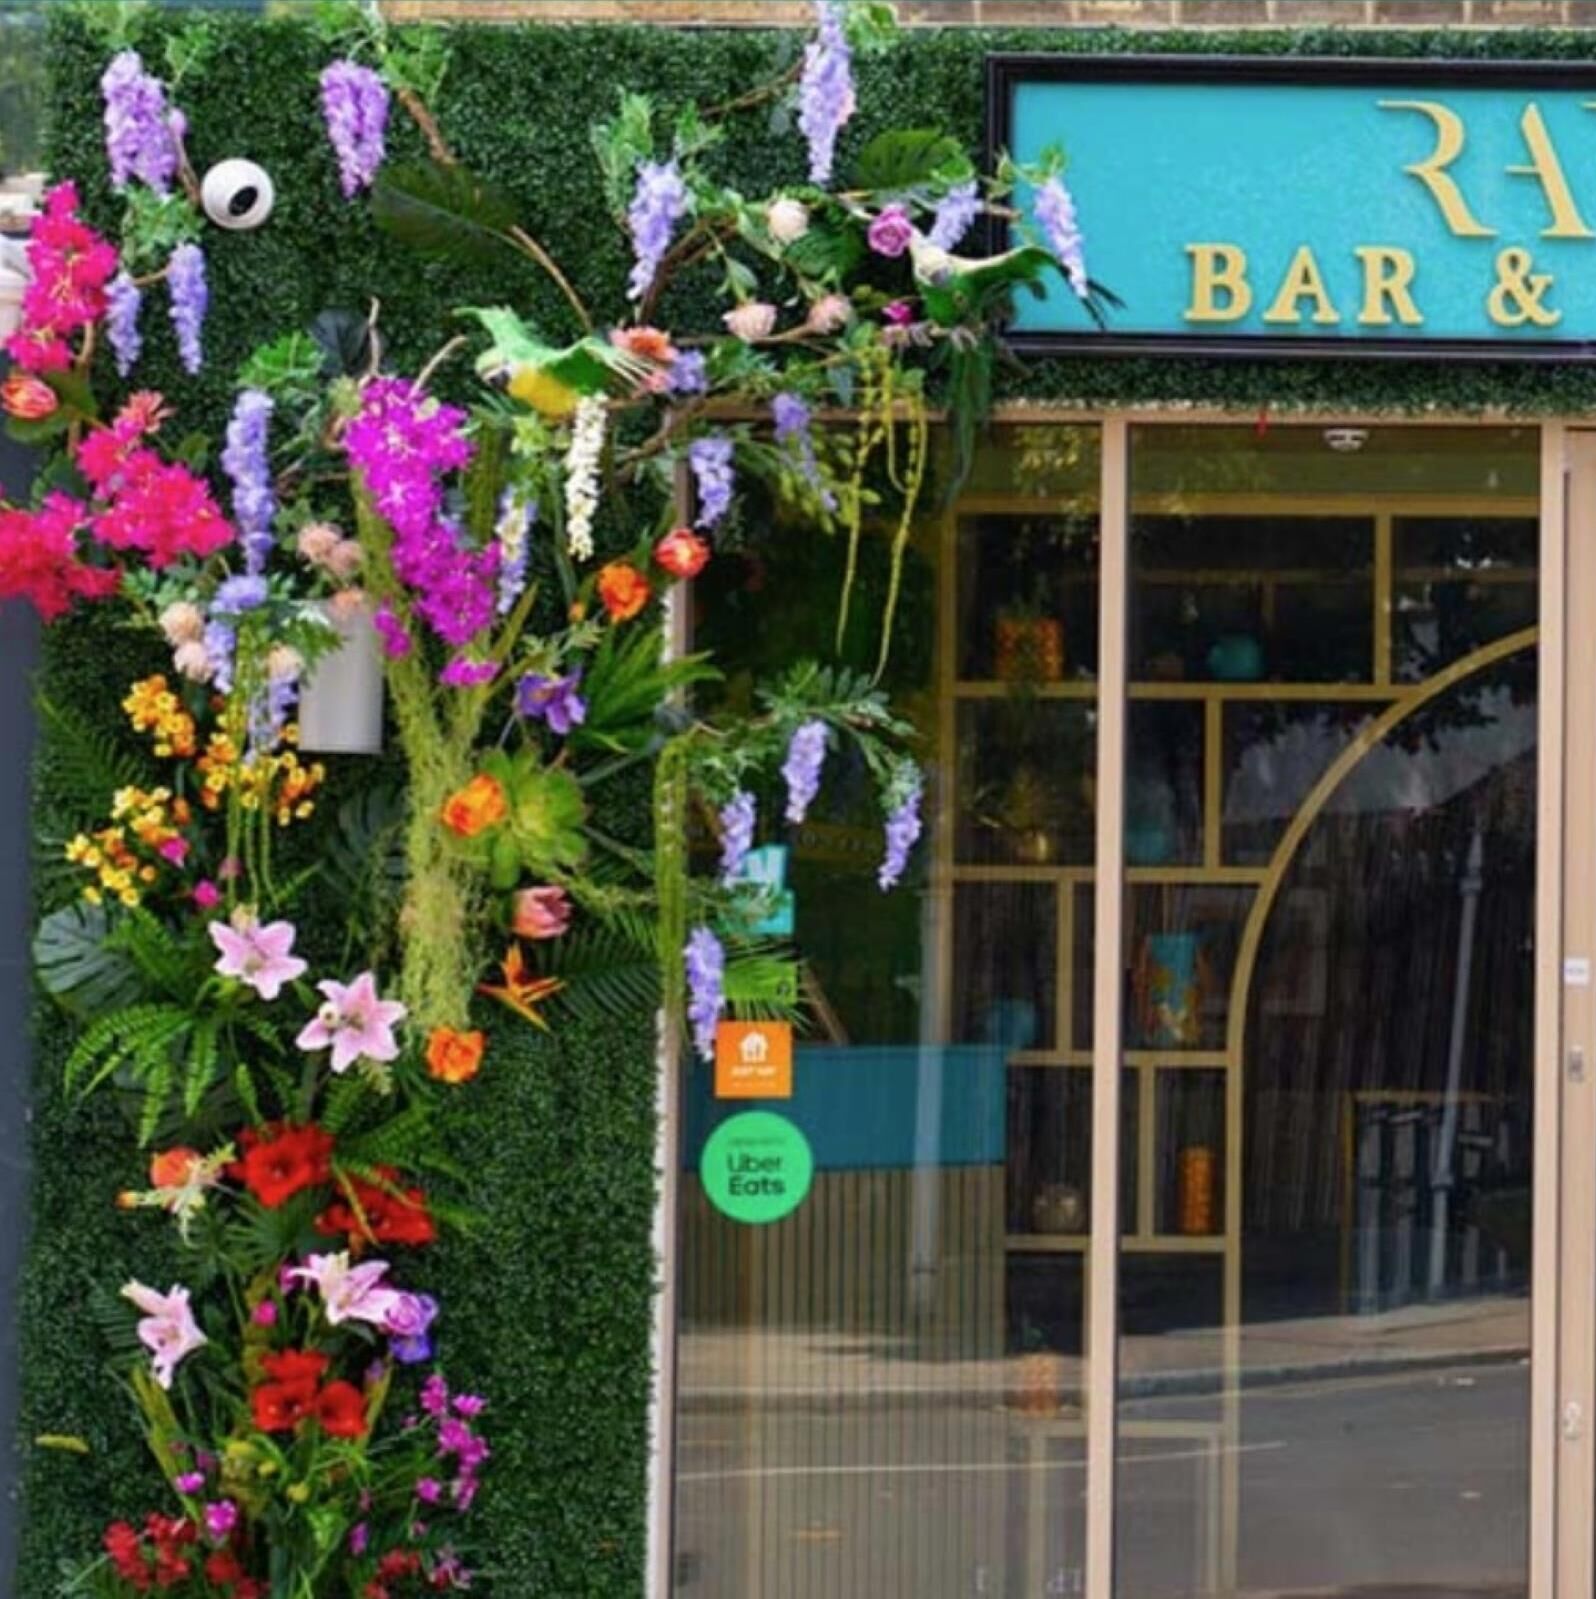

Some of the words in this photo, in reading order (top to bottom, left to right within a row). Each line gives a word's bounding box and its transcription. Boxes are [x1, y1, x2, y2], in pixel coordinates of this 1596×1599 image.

[1182, 243, 1424, 325] BAR
[1486, 249, 1561, 327] &
[726, 1152, 783, 1173] Uber
[728, 1175, 787, 1196] Eats
